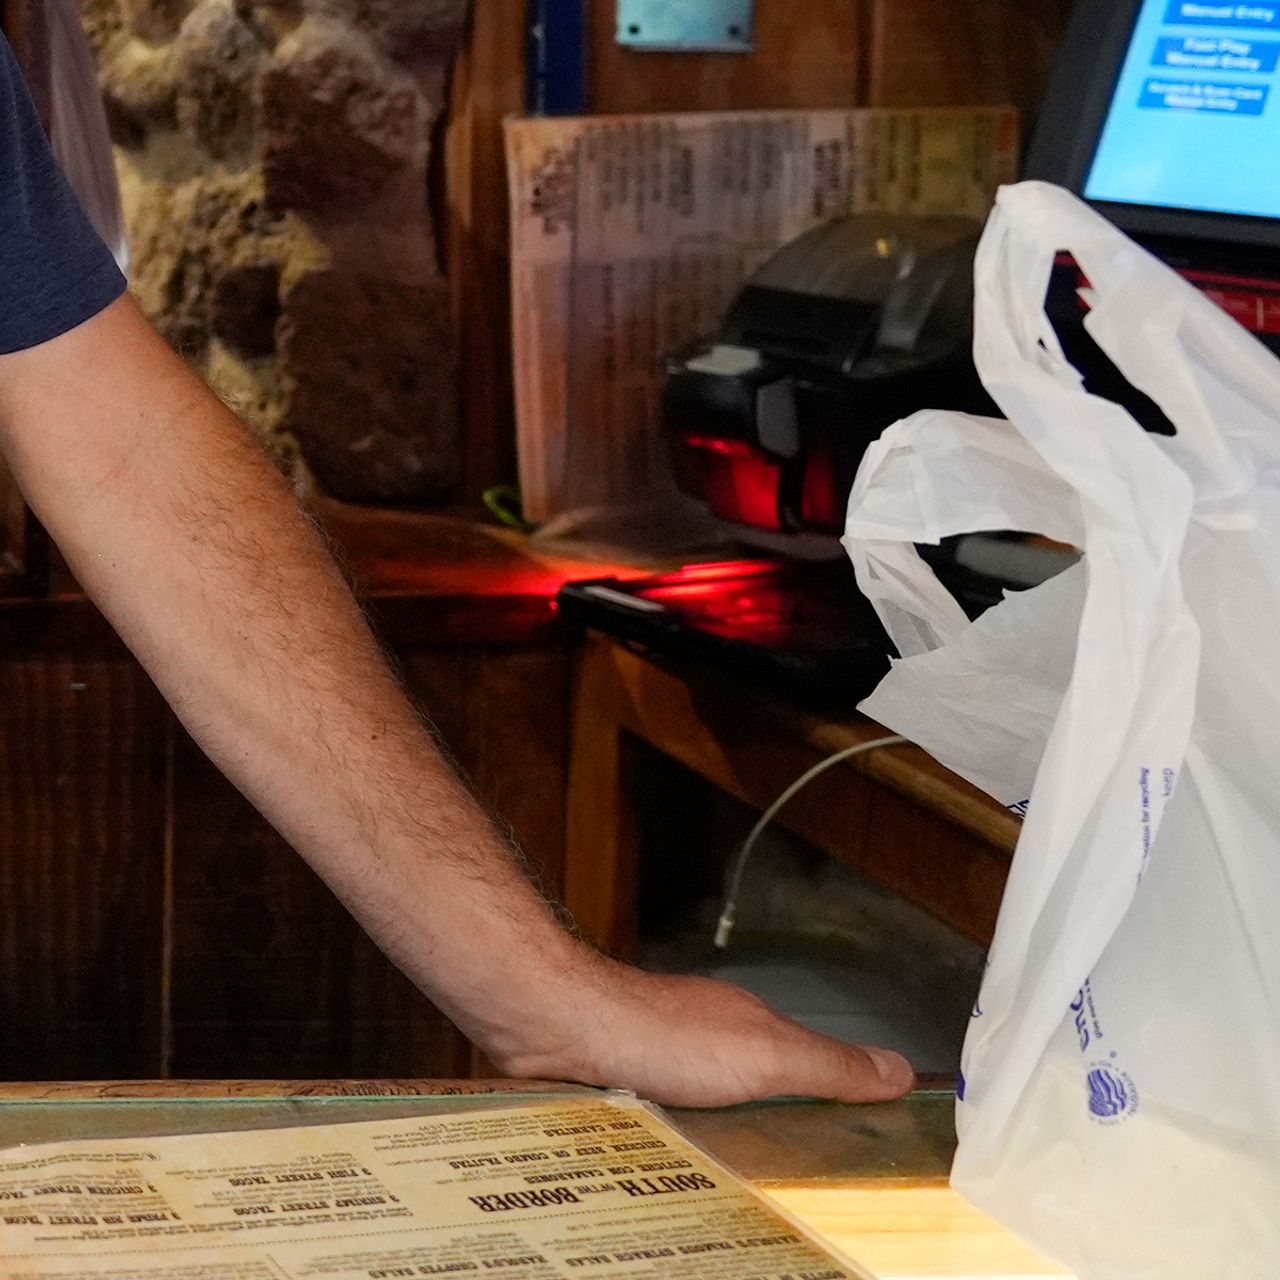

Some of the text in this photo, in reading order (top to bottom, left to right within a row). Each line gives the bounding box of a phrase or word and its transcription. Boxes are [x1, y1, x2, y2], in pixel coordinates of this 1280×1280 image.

[542, 1123, 605, 1137] CARNITAS
[608, 1119, 643, 1131] PORK
[610, 1139, 667, 1153] CHICKEN
[448, 1157, 502, 1170] FAJITAS
[504, 1151, 549, 1164] COMBO
[636, 1160, 693, 1173] CEVICHE
[274, 1171, 325, 1183] STREET
[327, 1168, 358, 1179] FISH
[523, 1169, 602, 1185] CAMARONES
[228, 1175, 271, 1187] TACOS
[33, 1184, 83, 1197] STREET
[88, 1184, 145, 1196] CHICKEN
[467, 1171, 716, 1213] SOUTH OF THE BORDER
[280, 1200, 331, 1212] STREET
[335, 1195, 387, 1208] SHRIMP
[233, 1205, 275, 1216] TACOS
[3, 1214, 43, 1226] TACOS
[47, 1214, 99, 1226] STREET
